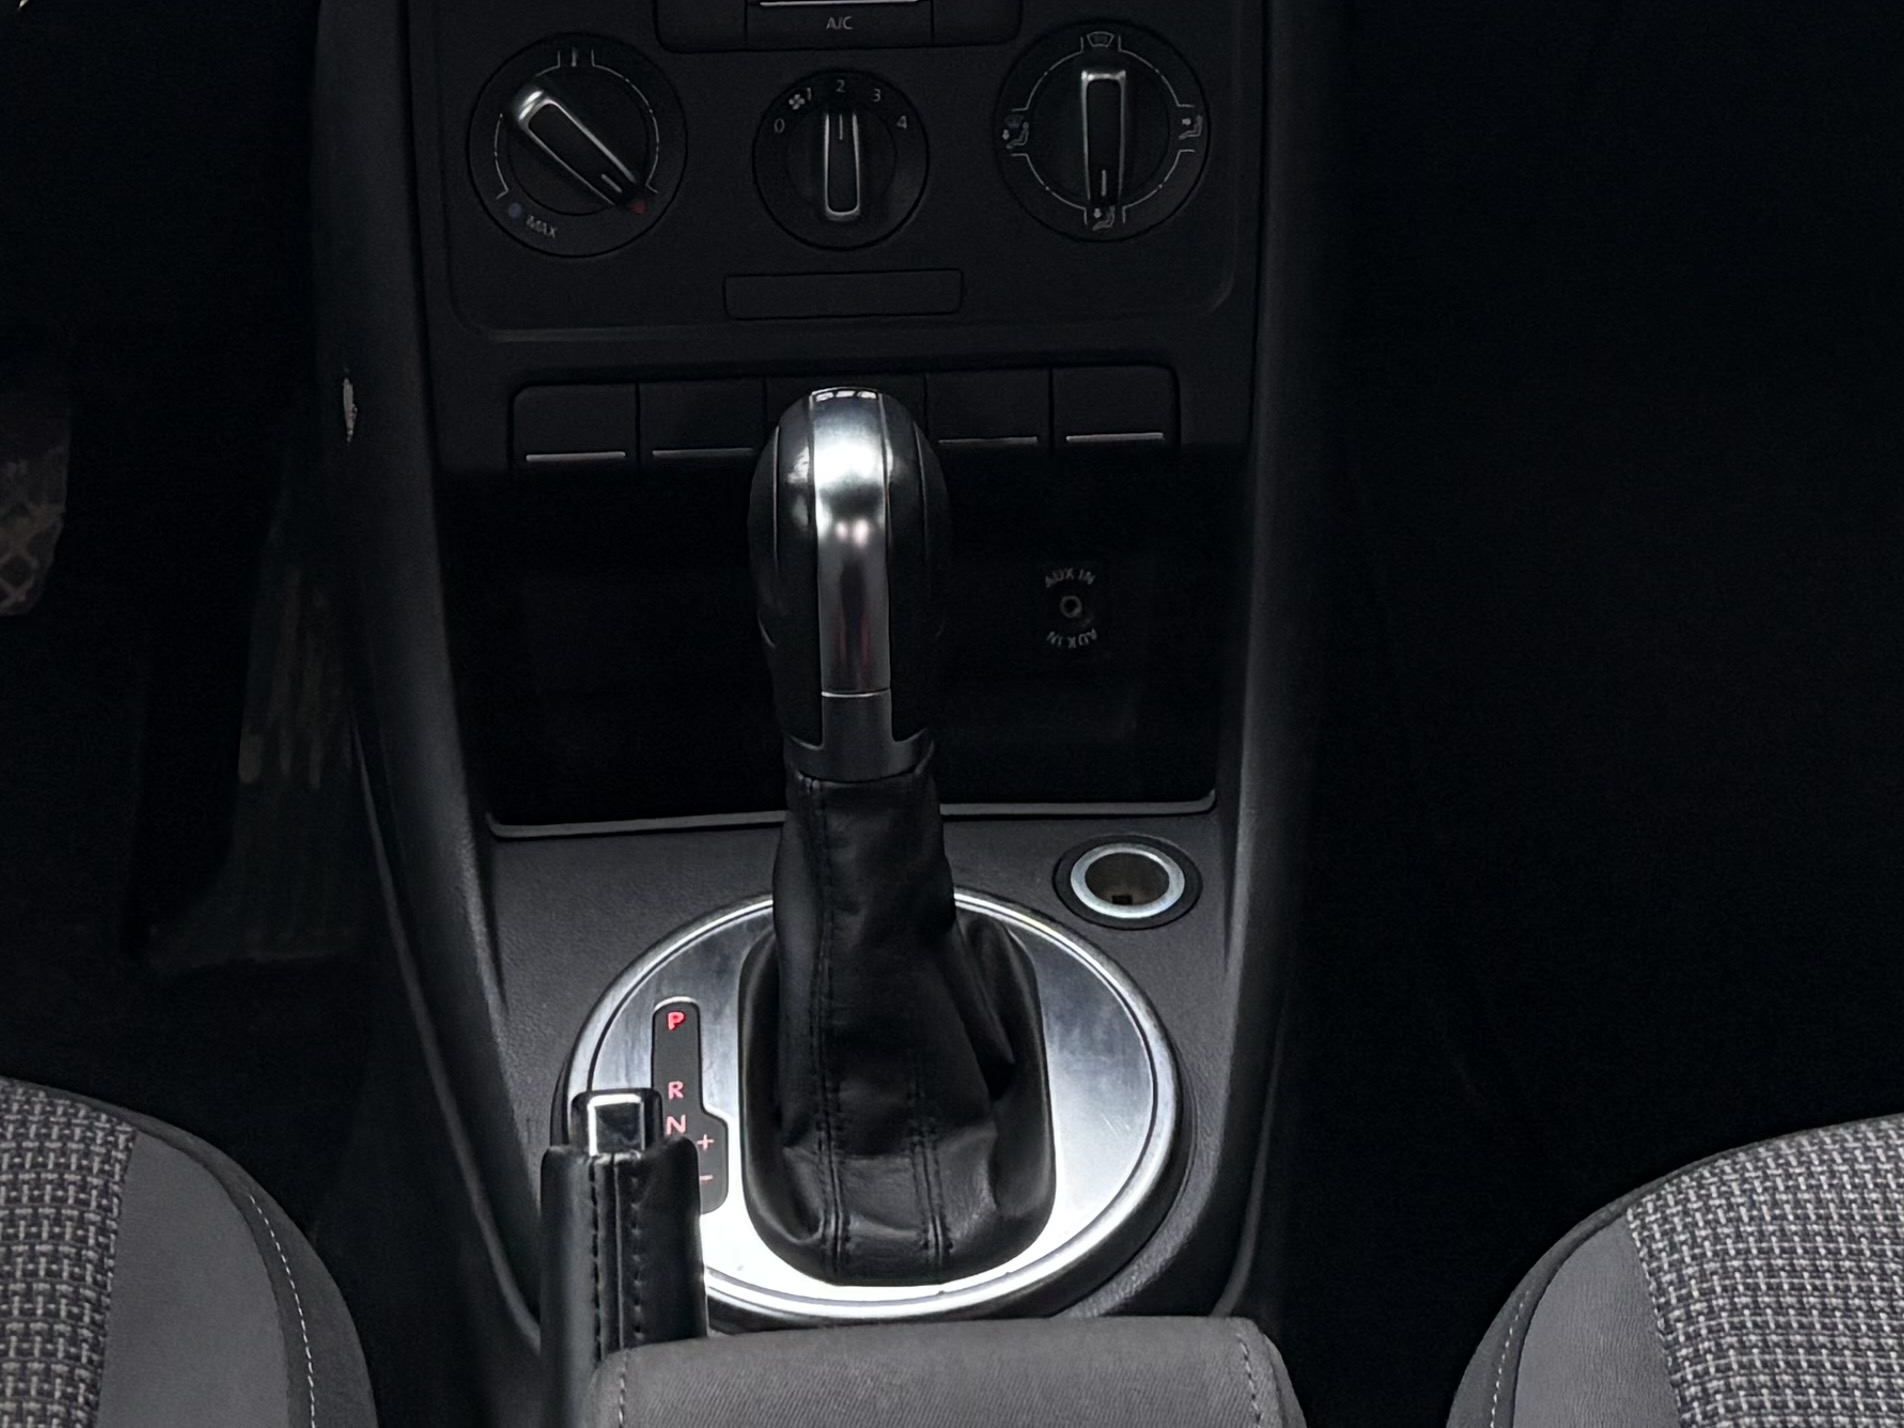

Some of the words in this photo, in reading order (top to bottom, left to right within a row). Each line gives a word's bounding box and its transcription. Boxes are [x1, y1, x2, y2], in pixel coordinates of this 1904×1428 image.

[826, 15, 854, 32] A/C
[834, 77, 847, 95] 2
[871, 87, 883, 103] 3
[896, 114, 910, 131] 4
[524, 214, 560, 240] MAX
[1044, 567, 1075, 589] AUX
[667, 1010, 687, 1031] P
[668, 1080, 684, 1100] R
[665, 1115, 687, 1136] N
